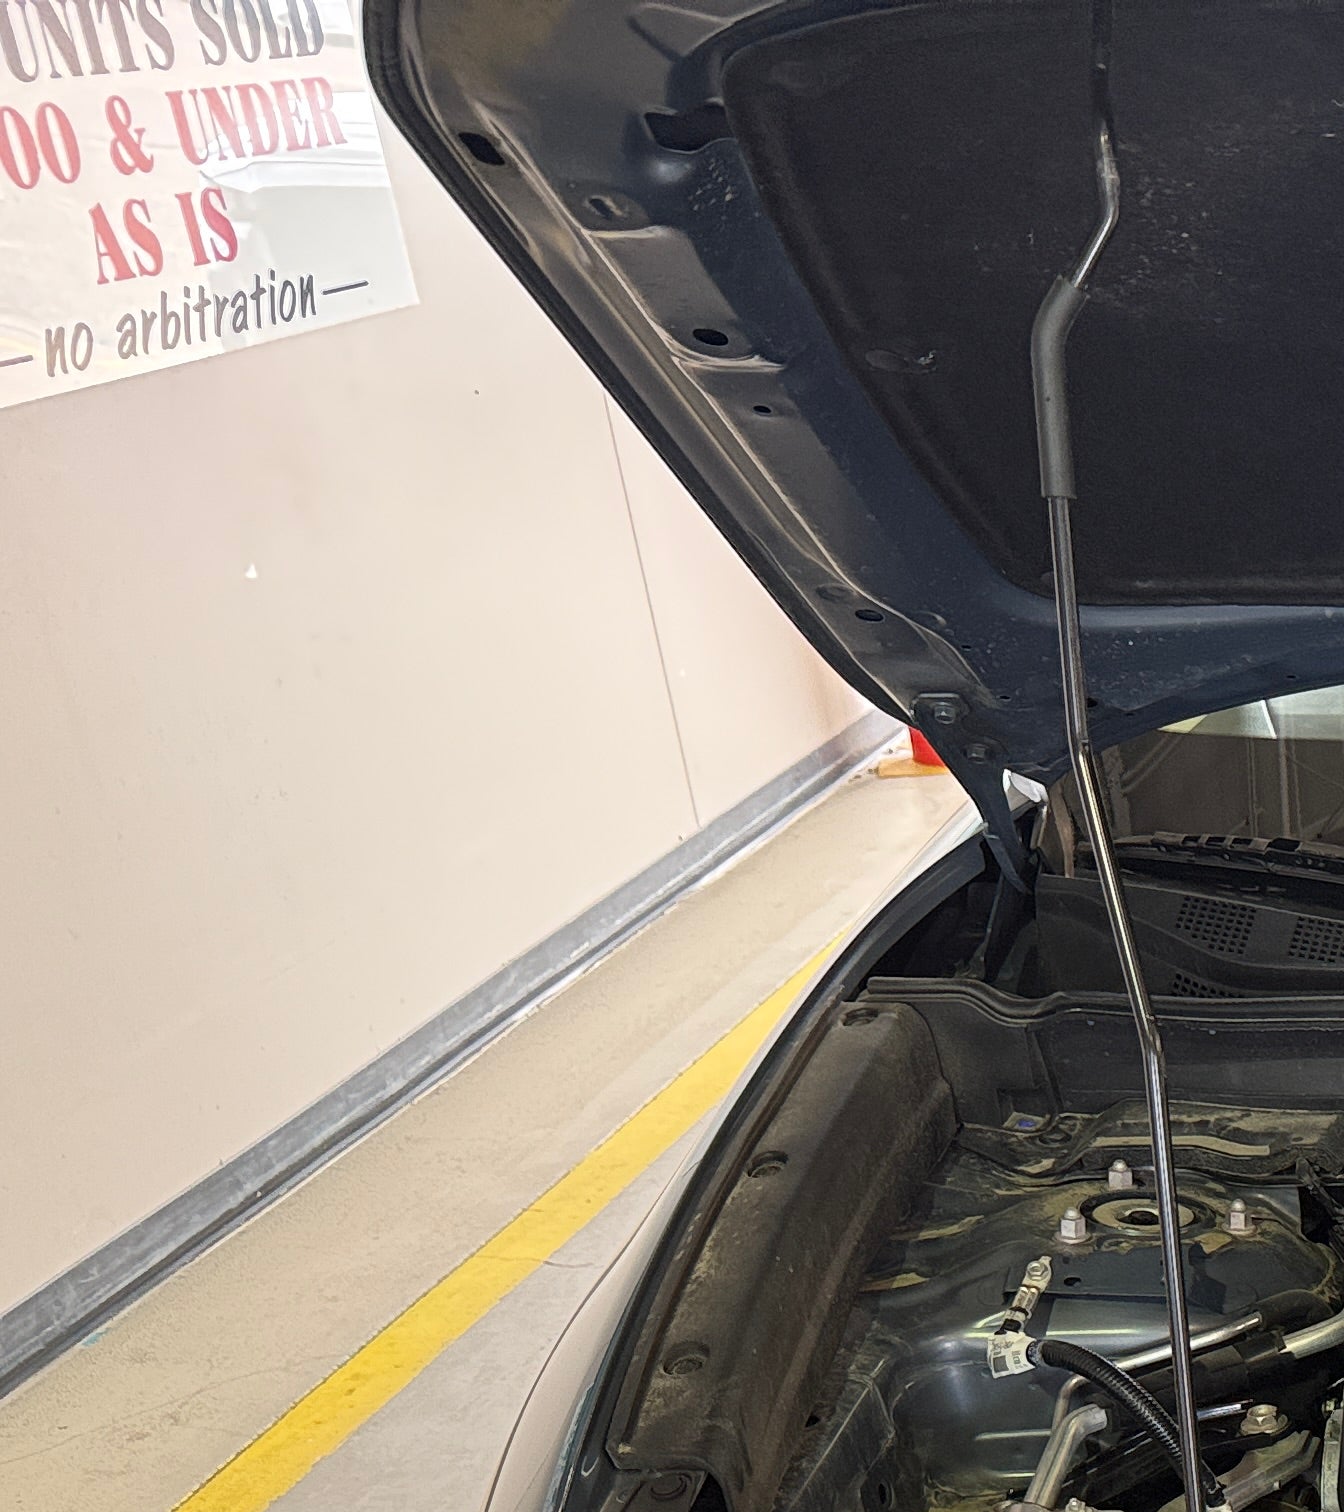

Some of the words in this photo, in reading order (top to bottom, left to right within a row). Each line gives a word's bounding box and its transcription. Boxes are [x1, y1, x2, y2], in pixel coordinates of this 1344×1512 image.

[0, 0, 175, 82] UNITS
[192, 0, 325, 66] SOLD
[105, 95, 154, 175] &
[165, 77, 347, 165] UNDER
[89, 198, 163, 285] AS
[174, 187, 238, 267] IS
